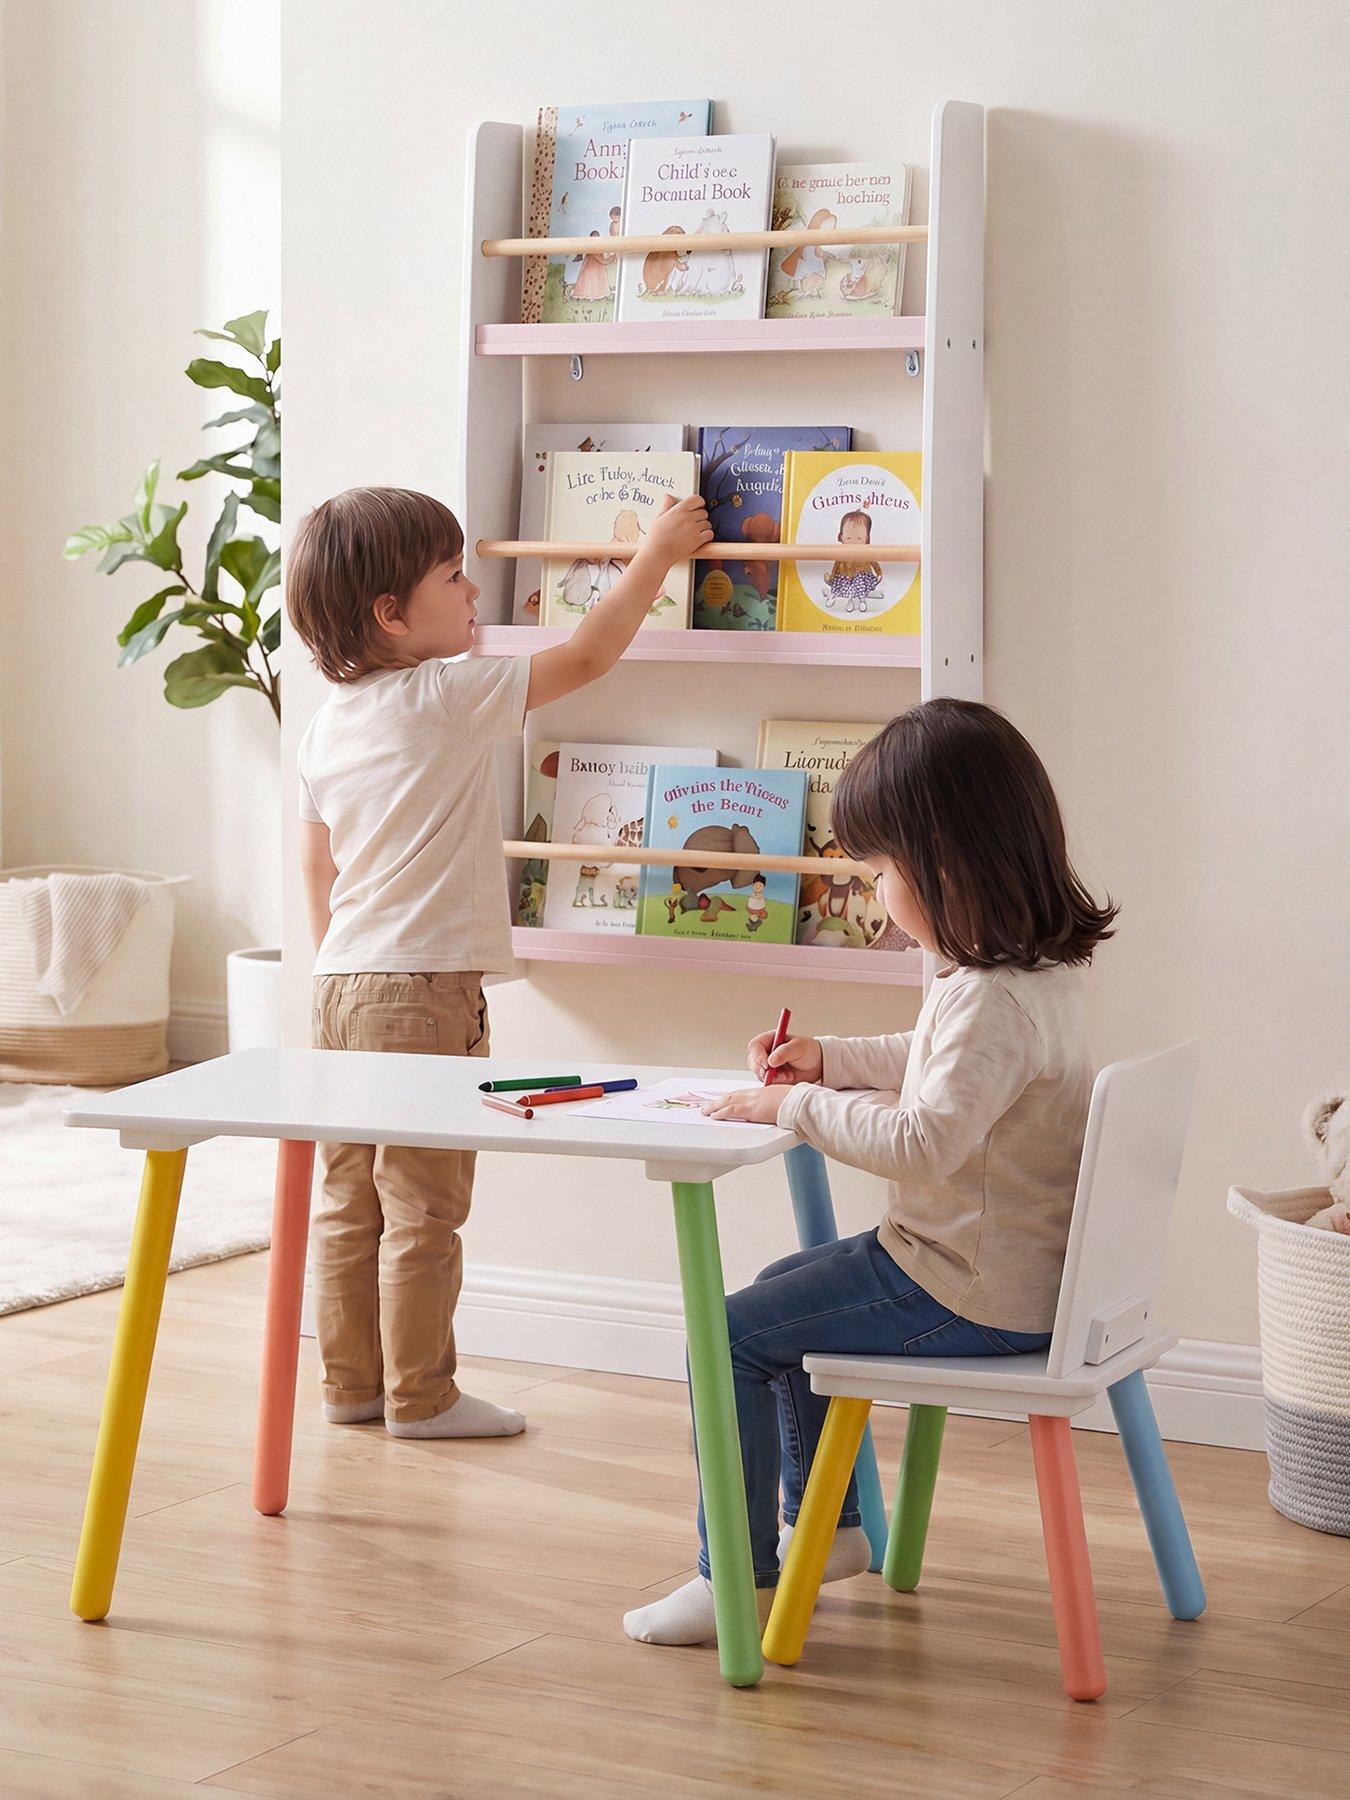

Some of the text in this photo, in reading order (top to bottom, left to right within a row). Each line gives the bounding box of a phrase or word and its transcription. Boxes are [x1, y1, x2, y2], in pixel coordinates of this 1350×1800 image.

[711, 182, 752, 201] Book
[719, 778, 743, 793] the
[690, 799, 715, 814] the
